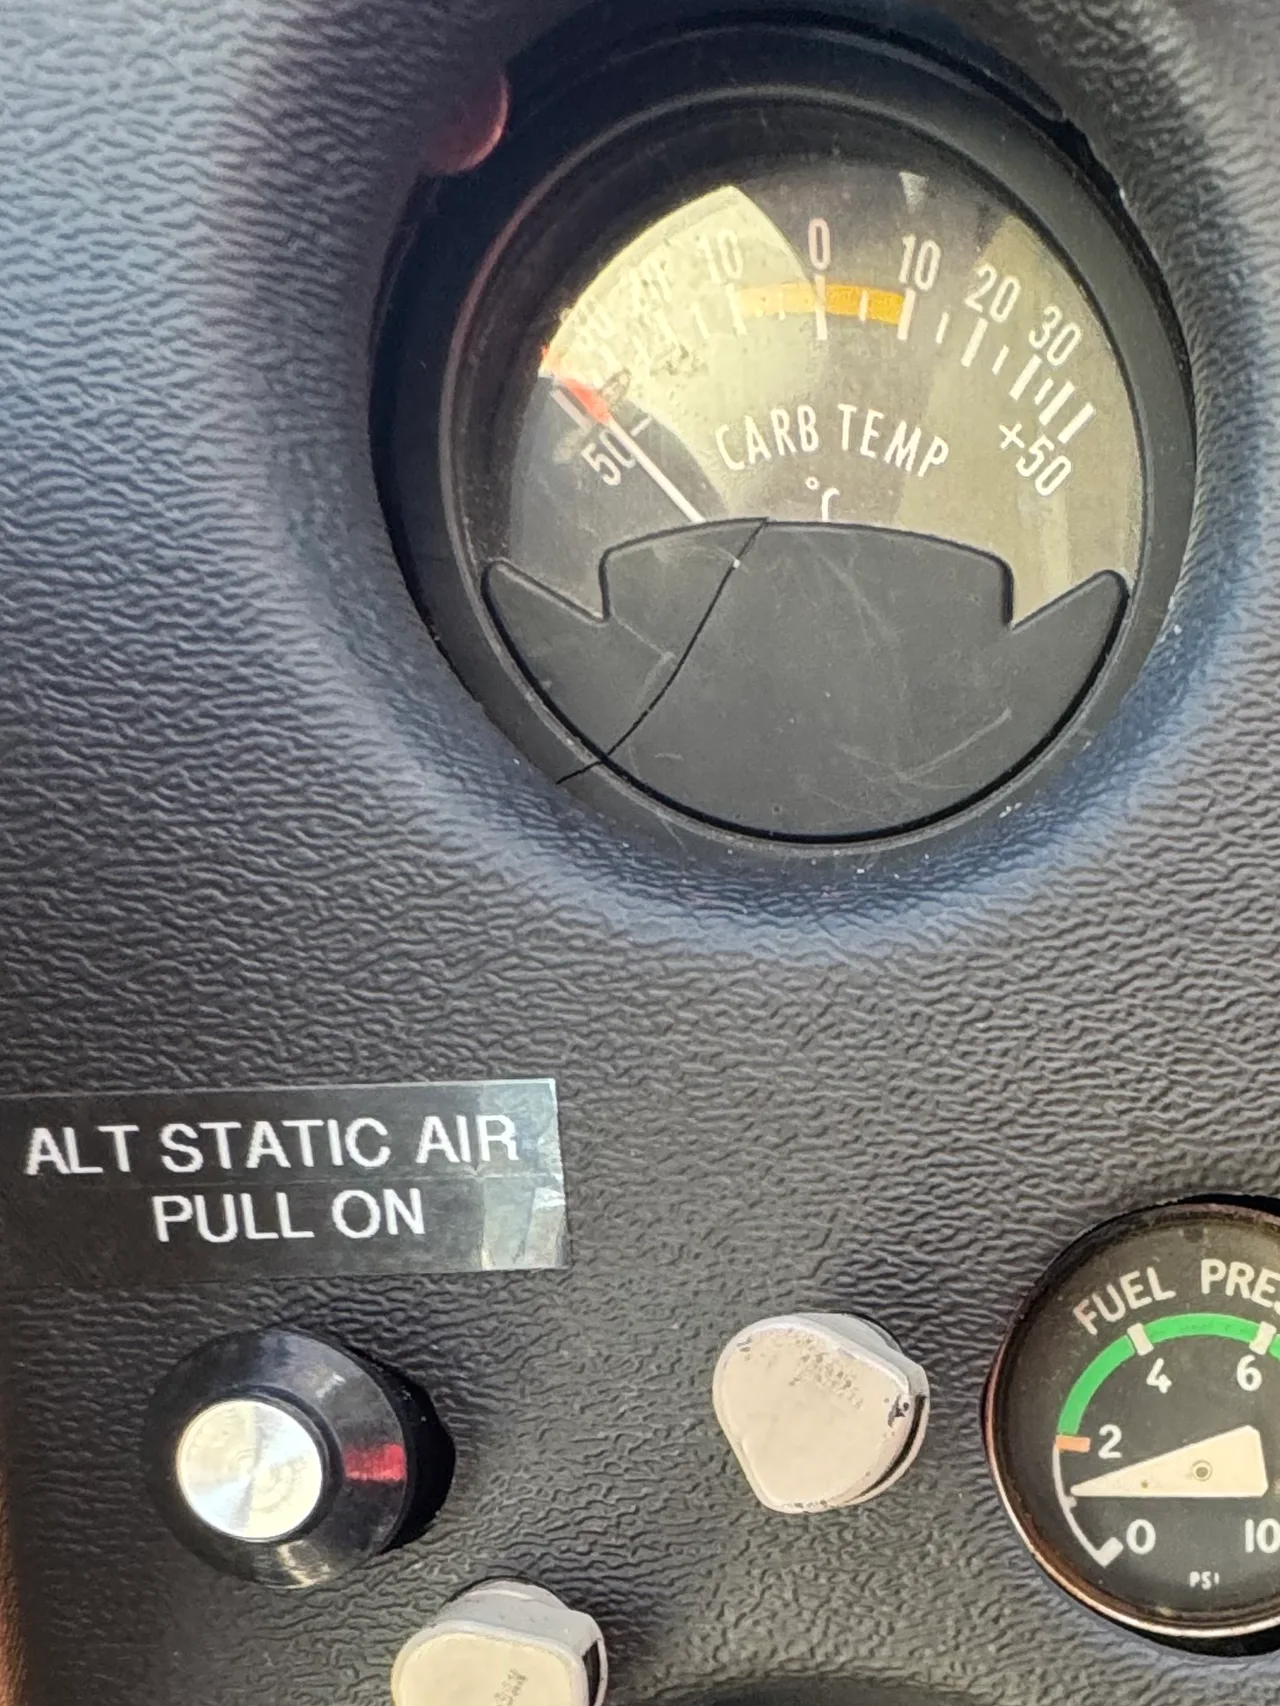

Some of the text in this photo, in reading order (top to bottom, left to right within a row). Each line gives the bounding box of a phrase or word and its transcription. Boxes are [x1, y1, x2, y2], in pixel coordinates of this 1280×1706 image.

[808, 218, 830, 270] 0
[899, 234, 941, 291] 10
[964, 263, 1021, 323] 20
[1029, 305, 1081, 366] 30
[716, 403, 949, 477] CARB TEMP
[999, 422, 1072, 496] +50
[24, 1114, 520, 1176] ALT STATIC AIR
[151, 1187, 427, 1244] PULL ON
[1072, 1266, 1177, 1336] FUEL
[1146, 1357, 1172, 1394] 4
[1236, 1355, 1262, 1391] 6
[1098, 1424, 1123, 1460] 2
[1126, 1517, 1156, 1555] 0
[1189, 1571, 1220, 1591] PSI
